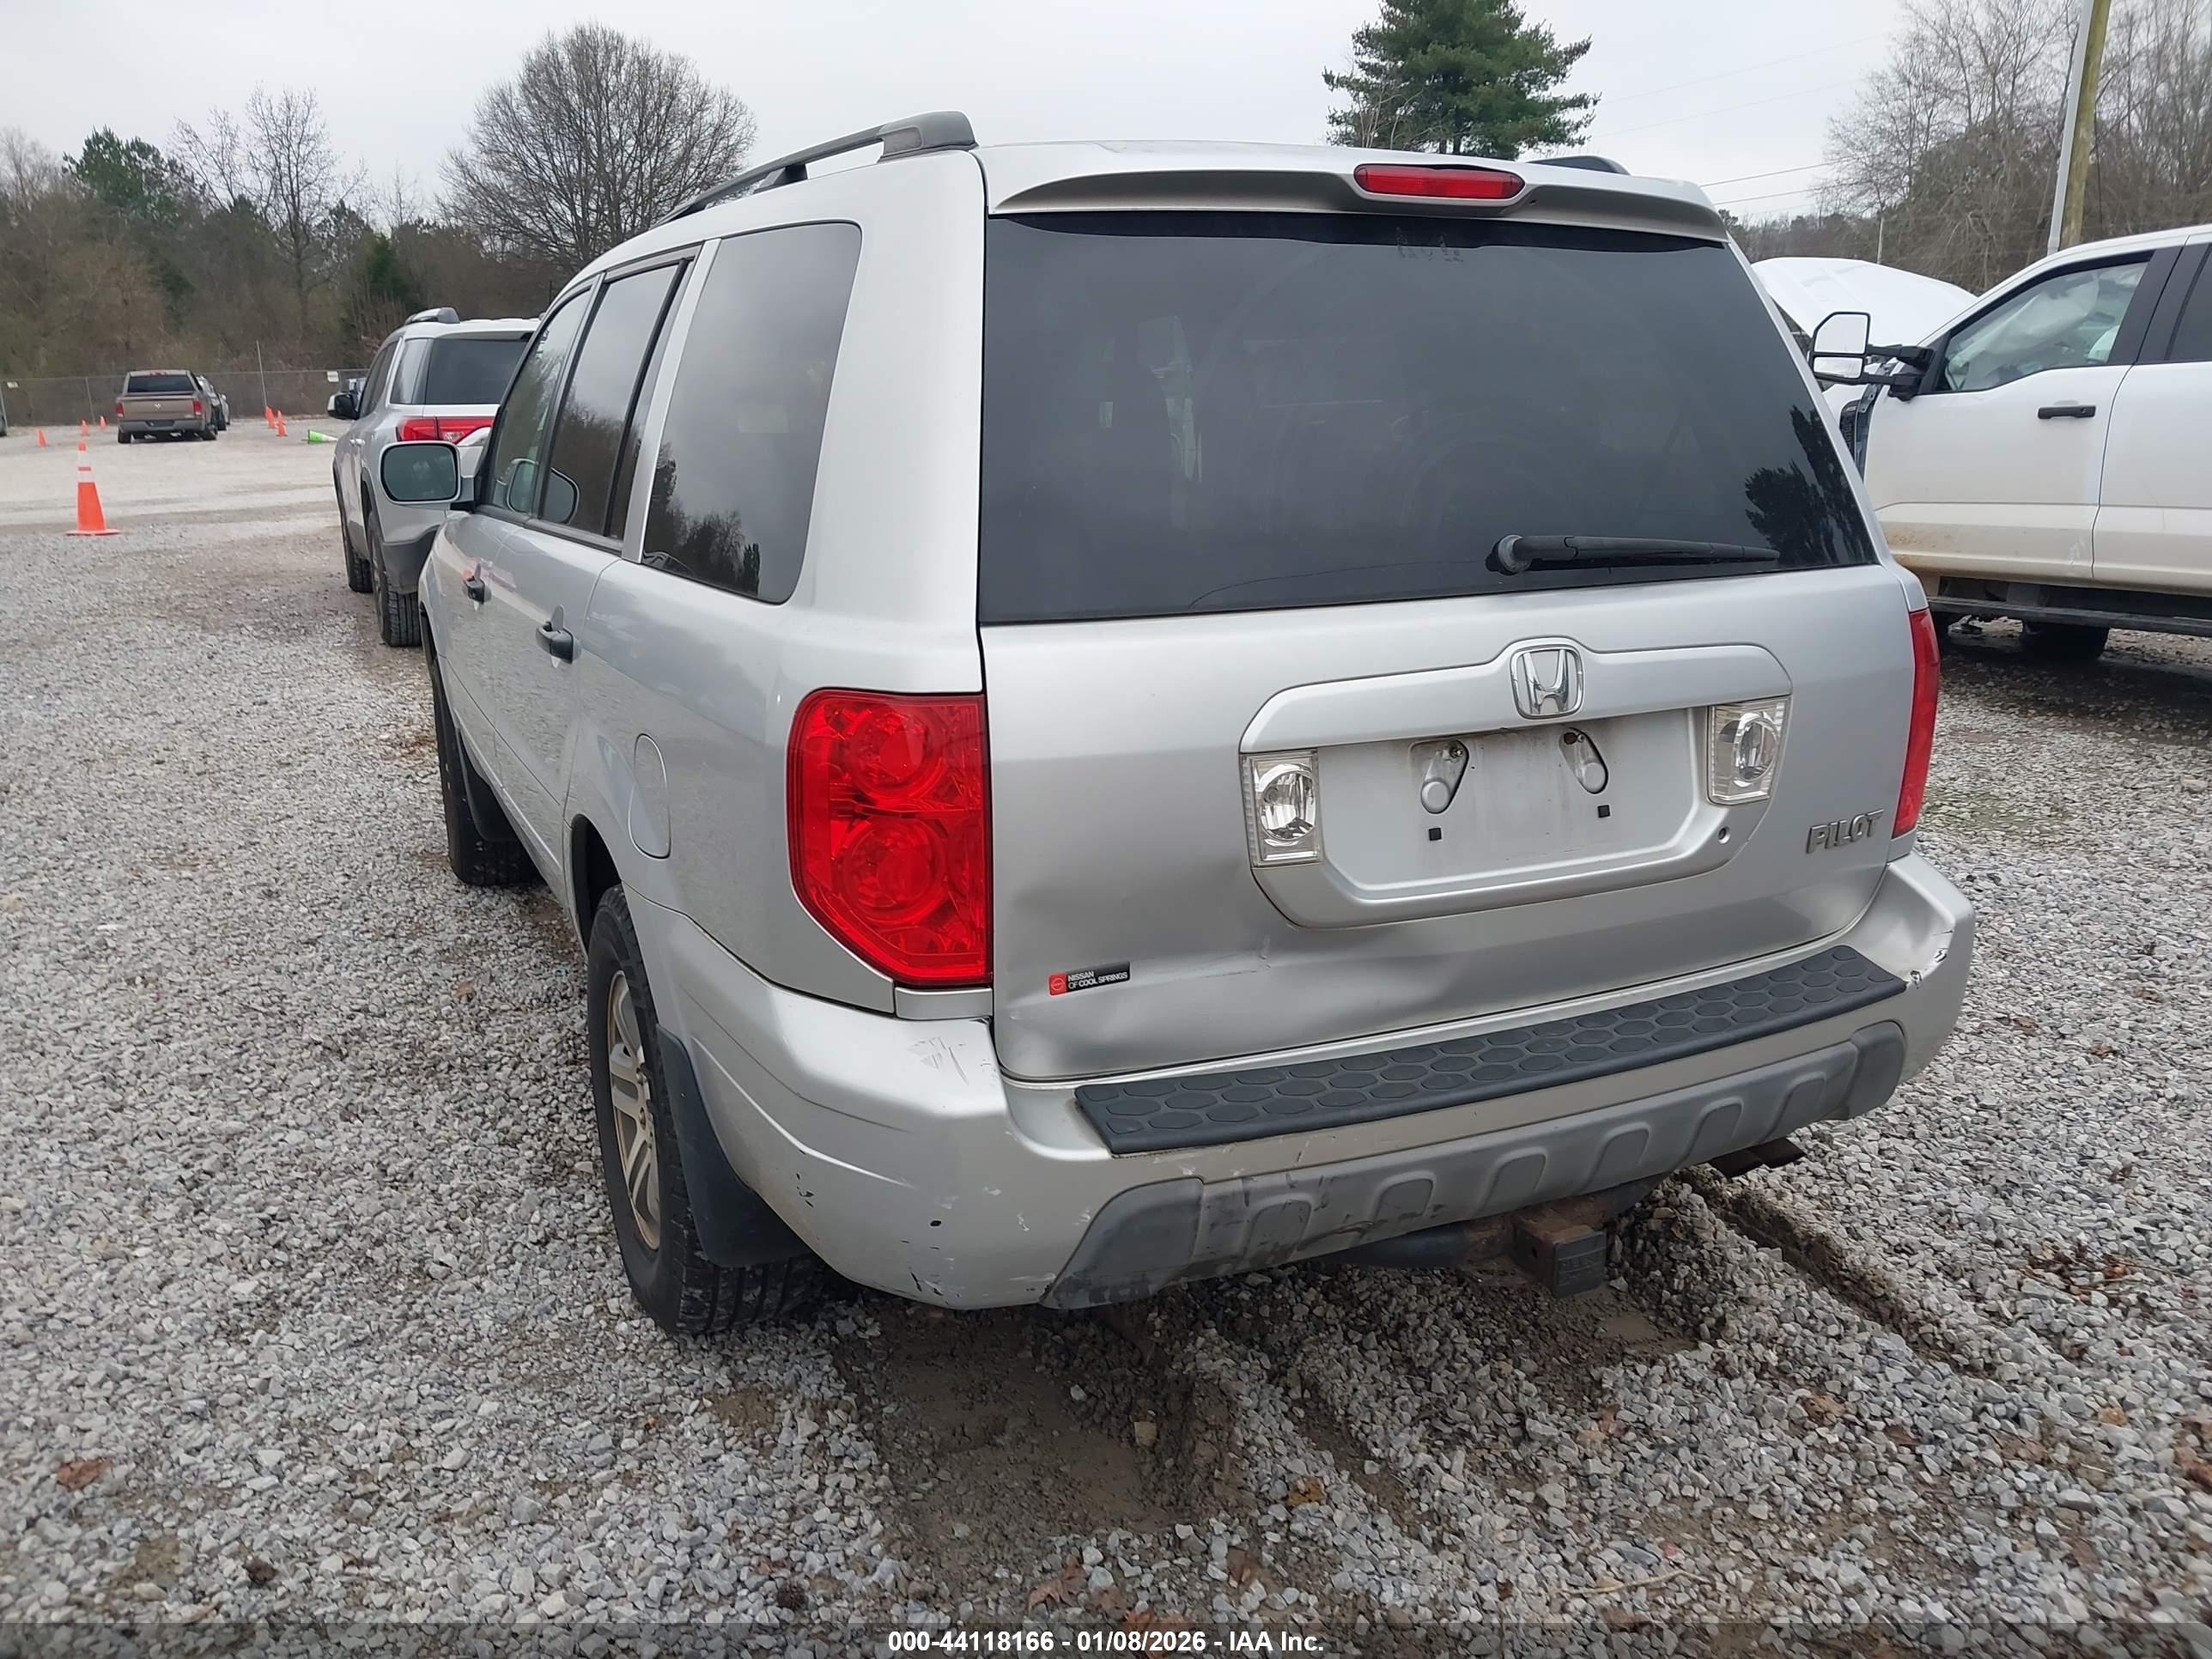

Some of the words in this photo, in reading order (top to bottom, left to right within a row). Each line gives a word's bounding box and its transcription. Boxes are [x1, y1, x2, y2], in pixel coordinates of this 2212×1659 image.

[1806, 808, 1884, 854] PILOT
[1068, 970, 1095, 981] NISSAN
[1079, 978, 1098, 988] COOL
[1098, 972, 1127, 983] SPRINGS
